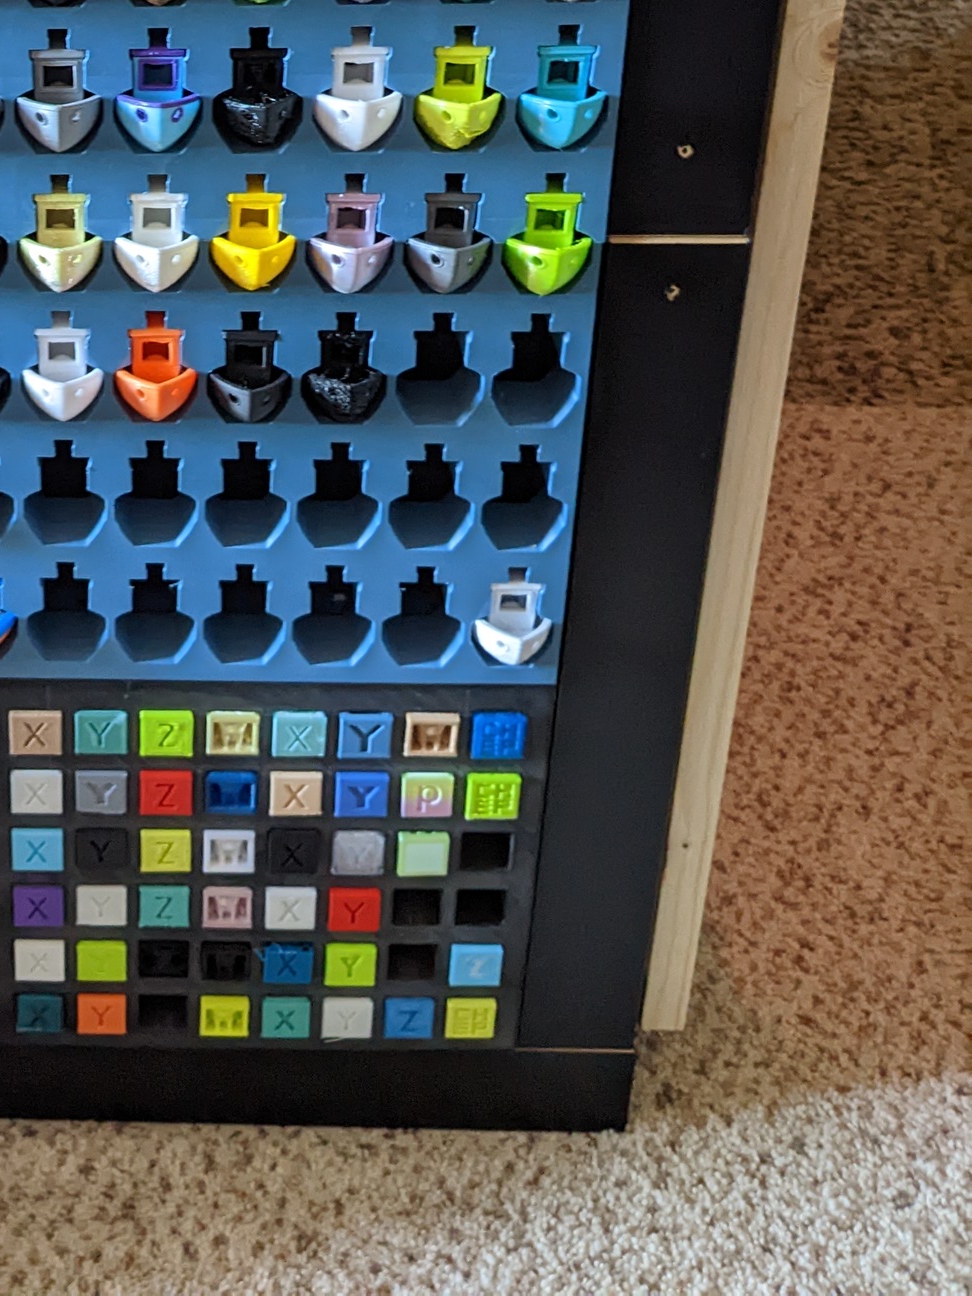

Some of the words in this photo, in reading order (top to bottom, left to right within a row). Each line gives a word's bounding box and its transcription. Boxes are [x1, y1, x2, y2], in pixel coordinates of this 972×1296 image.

[23, 722, 47, 747] X
[85, 722, 116, 748] Y
[158, 723, 174, 747] Z
[286, 726, 312, 751] X
[349, 724, 385, 753] Y
[25, 783, 48, 805] X
[86, 782, 117, 806] Y
[156, 783, 174, 808] Z
[283, 784, 308, 809] X
[347, 786, 379, 809] Y
[26, 840, 46, 862] X
[89, 840, 113, 863] Y
[156, 841, 174, 864] Z
[281, 843, 304, 867] X
[28, 896, 47, 919] X
[92, 896, 111, 917] Y
[155, 896, 173, 919] Z
[279, 899, 300, 922] X
[344, 902, 364, 924] Y
[30, 952, 48, 973] X
[278, 953, 297, 976] X
[340, 955, 362, 978] Y
[91, 1006, 111, 1026] Y
[275, 1010, 295, 1031] X
[338, 1011, 357, 1031] Y
[399, 1010, 419, 1033] Z
